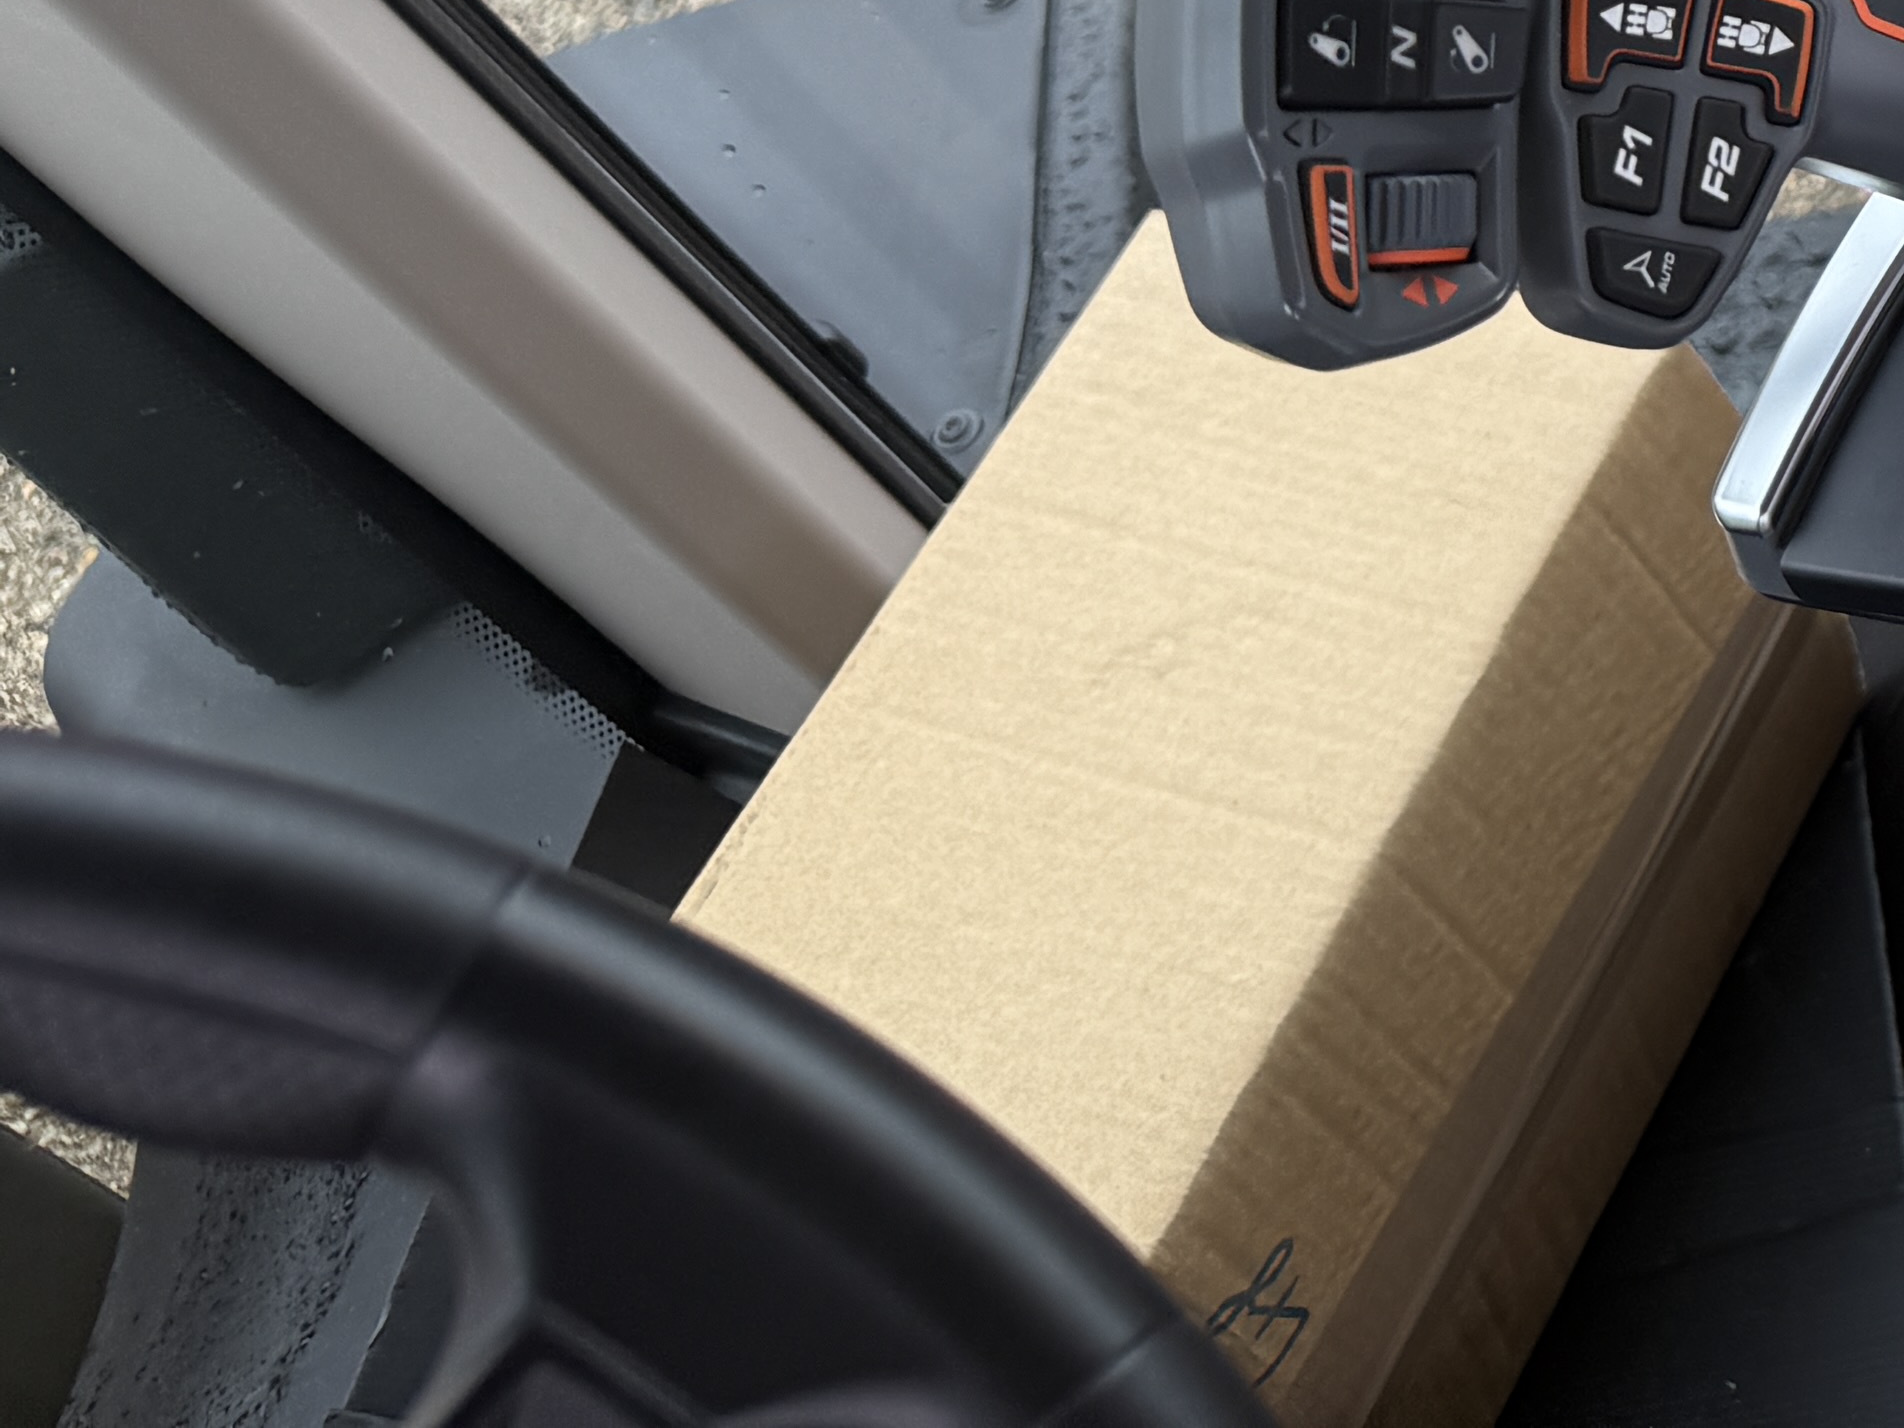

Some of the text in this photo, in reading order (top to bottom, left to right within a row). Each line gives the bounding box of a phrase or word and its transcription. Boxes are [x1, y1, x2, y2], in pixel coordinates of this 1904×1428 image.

[1390, 24, 1417, 70] N
[1613, 124, 1654, 187] F1
[1701, 136, 1740, 203] F2
[1656, 250, 1677, 295] AUTO
